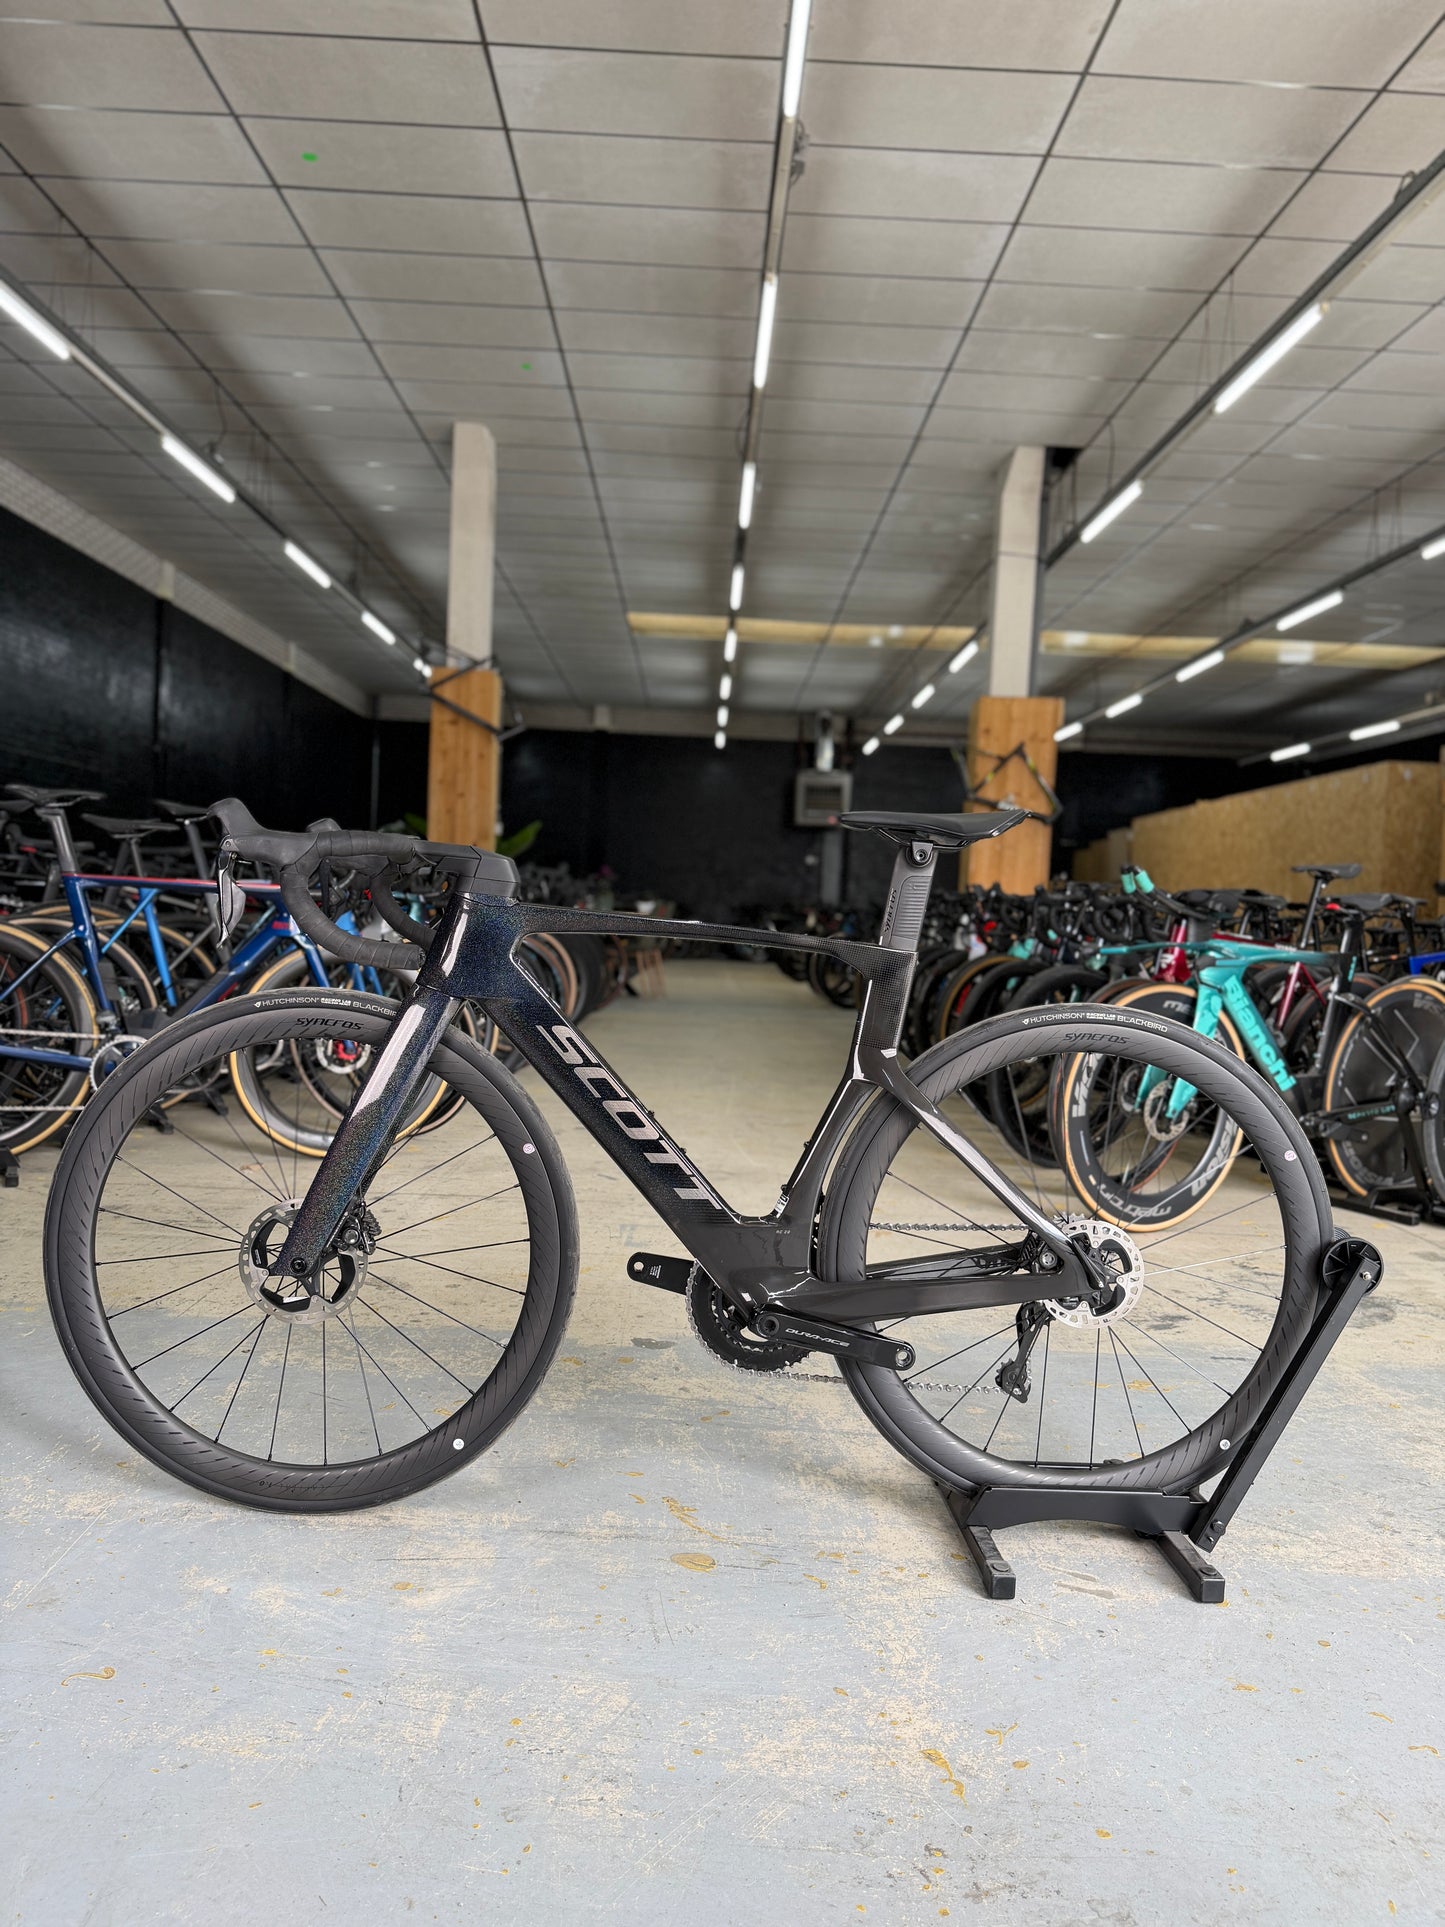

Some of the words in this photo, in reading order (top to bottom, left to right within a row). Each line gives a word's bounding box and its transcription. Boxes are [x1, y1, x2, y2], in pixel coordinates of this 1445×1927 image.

[262, 997, 317, 1007] HUTCHINSON
[352, 1001, 397, 1016] BLACKBIR
[1030, 1012, 1083, 1023] HUTCHINSON
[1117, 1015, 1168, 1033] BLACKBIRD
[1224, 974, 1297, 1092] Bianchi
[535, 1025, 722, 1210] SCOTT
